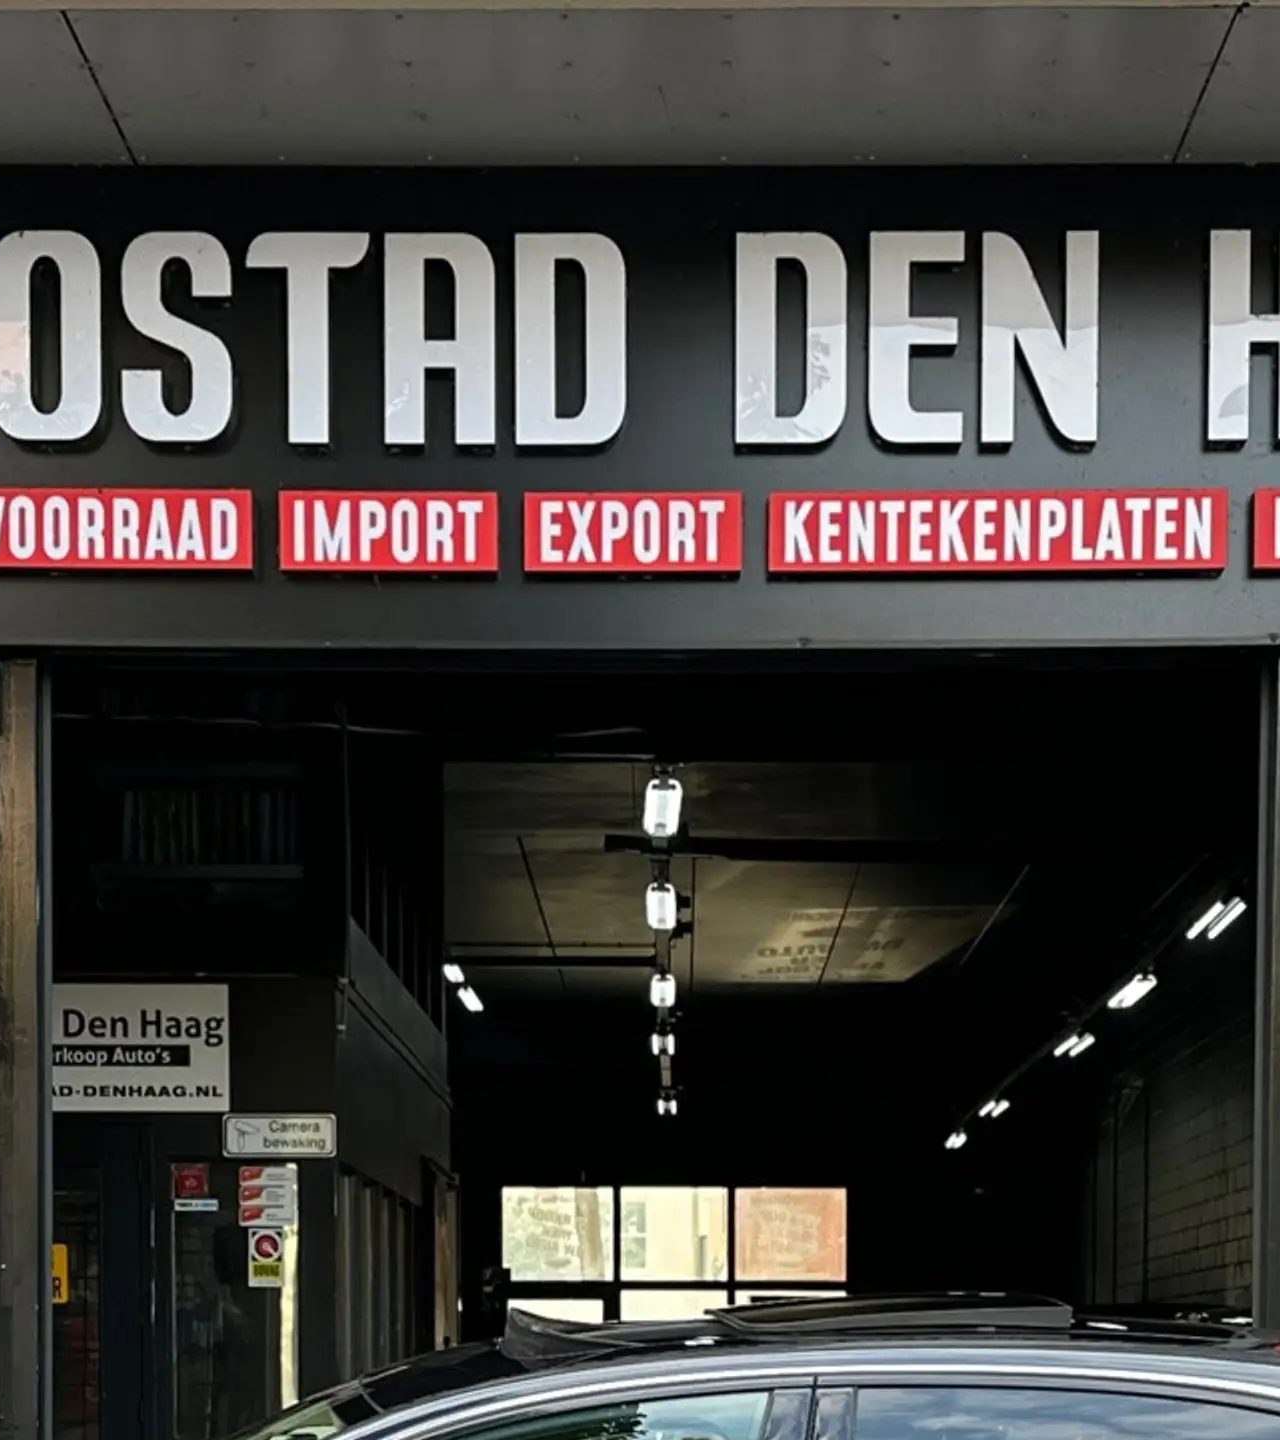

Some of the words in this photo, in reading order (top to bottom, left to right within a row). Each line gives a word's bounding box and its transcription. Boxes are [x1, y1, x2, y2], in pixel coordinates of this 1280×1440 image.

[733, 229, 1100, 446] DEN
[291, 497, 484, 563] IMPORT
[540, 498, 726, 563] EXPORT
[783, 495, 1213, 563] KENTEKENPLATEN
[53, 1049, 108, 1067] rkoop
[112, 1047, 171, 1064] Auto's
[62, 1008, 129, 1038] Den
[140, 1008, 225, 1047] Haag
[269, 1120, 320, 1133] Camera
